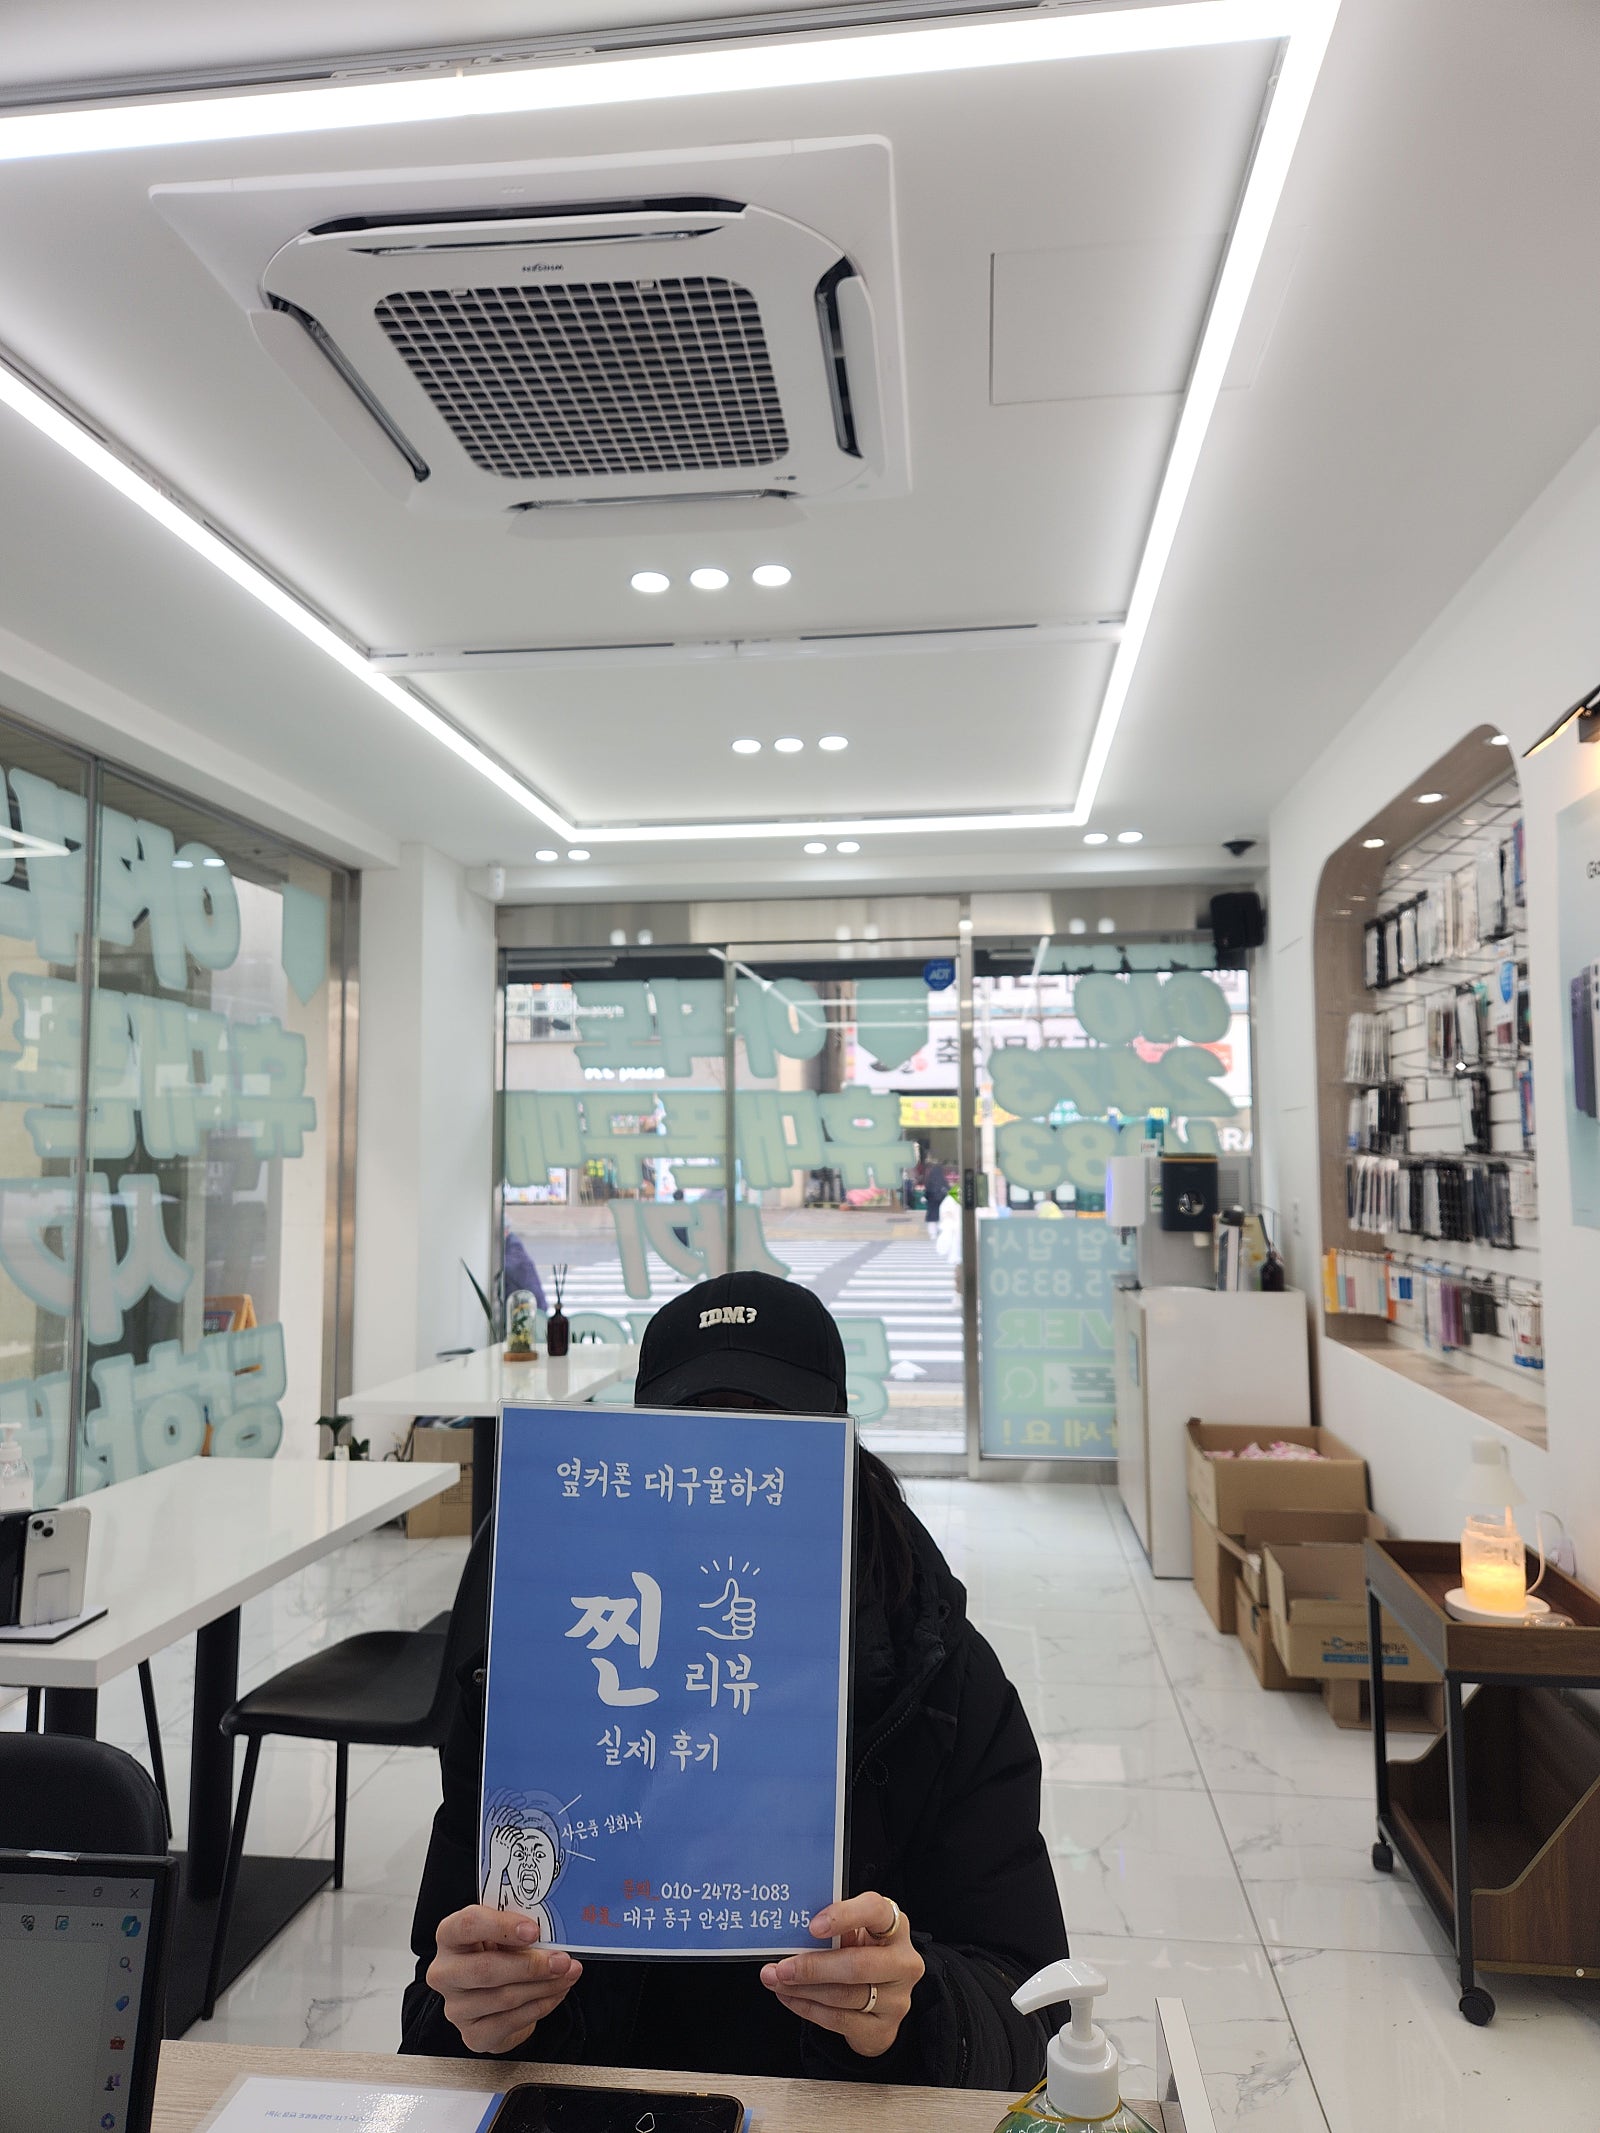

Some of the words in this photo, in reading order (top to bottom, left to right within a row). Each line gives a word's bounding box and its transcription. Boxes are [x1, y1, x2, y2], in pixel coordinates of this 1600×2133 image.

[928, 968, 952, 981] ADT
[556, 1457, 632, 1498] 옆커폰
[644, 1463, 785, 1506] 대구율하점
[564, 1571, 662, 1707] 찐
[685, 1652, 760, 1715] 리뷰
[596, 1724, 656, 1770] 실제
[669, 1729, 719, 1772] 후기
[603, 1811, 643, 1835] 실화냐
[661, 1880, 791, 1902] 010-2473-1083
[623, 1905, 657, 1930] 대구
[662, 1907, 693, 1931] 동구
[698, 1909, 744, 1931] 안심로
[750, 1908, 783, 1930] 16길
